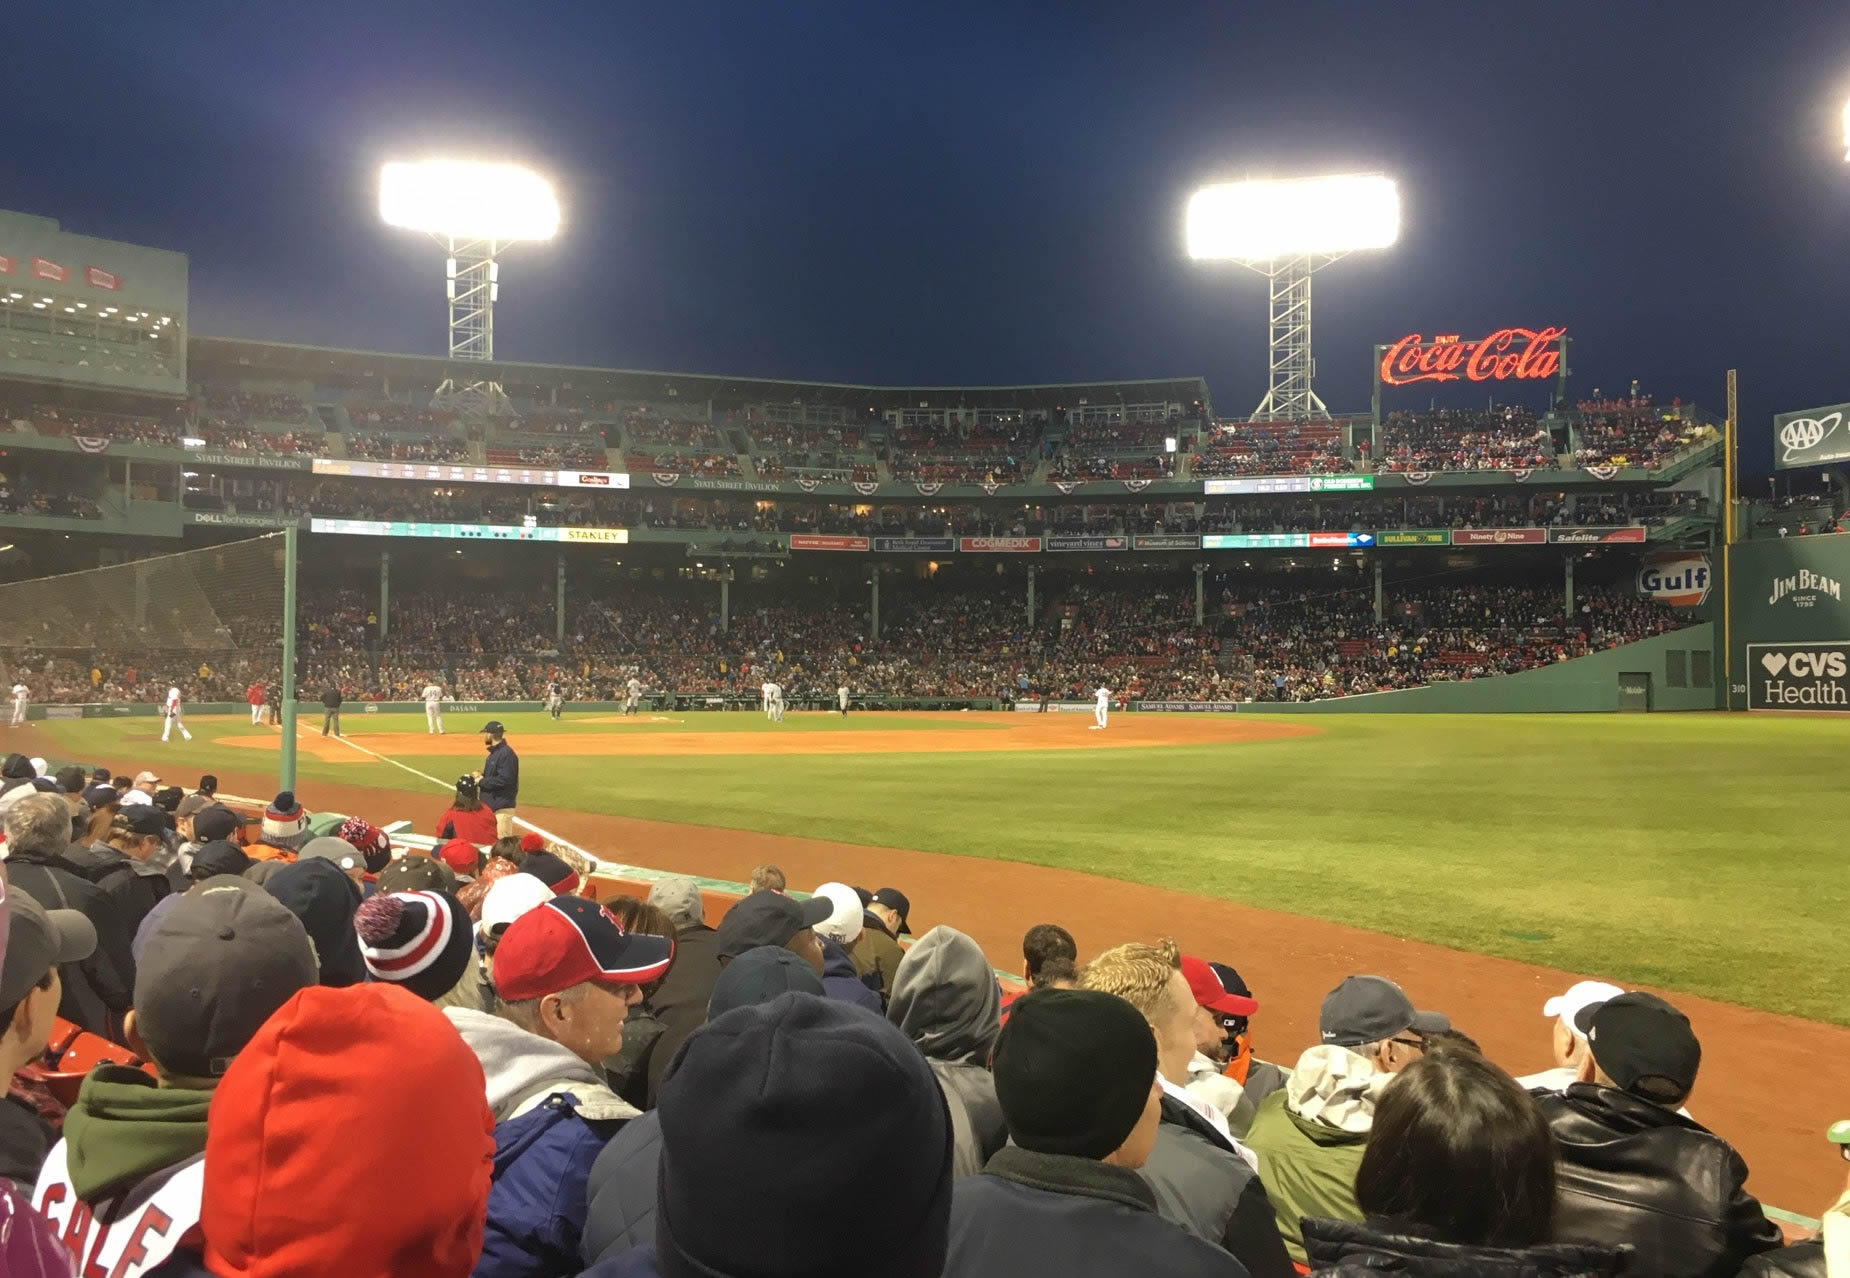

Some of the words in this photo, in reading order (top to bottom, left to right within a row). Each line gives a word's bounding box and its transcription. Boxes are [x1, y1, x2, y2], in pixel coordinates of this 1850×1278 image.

[1435, 335, 1460, 344] ENJOY
[1381, 327, 1567, 385] Coca-Cola
[1784, 420, 1820, 448] AAA
[195, 452, 221, 464] STATE
[223, 455, 255, 465] STREET
[259, 457, 301, 468] PAVILION
[694, 480, 715, 488] STATE
[716, 481, 743, 489] STREET
[745, 482, 780, 490] PAVILION
[195, 513, 221, 523] DELL
[568, 531, 619, 540] STANLEY
[1384, 534, 1417, 543] SULLIVAN
[1427, 534, 1442, 542] TIRE
[1470, 533, 1494, 541] Ninety
[1557, 534, 1600, 542] Safelite
[971, 538, 1030, 548] COGMEDIX
[1050, 539, 1082, 548] vineyard
[1083, 539, 1103, 548] vines
[1641, 567, 1708, 591] Gulf
[1768, 576, 1796, 605] JIM
[1799, 569, 1841, 601] BEAM
[1788, 651, 1848, 678] CVS
[1731, 684, 1747, 693] 310
[1764, 680, 1849, 705] Health
[1213, 703, 1233, 711] ADAMS
